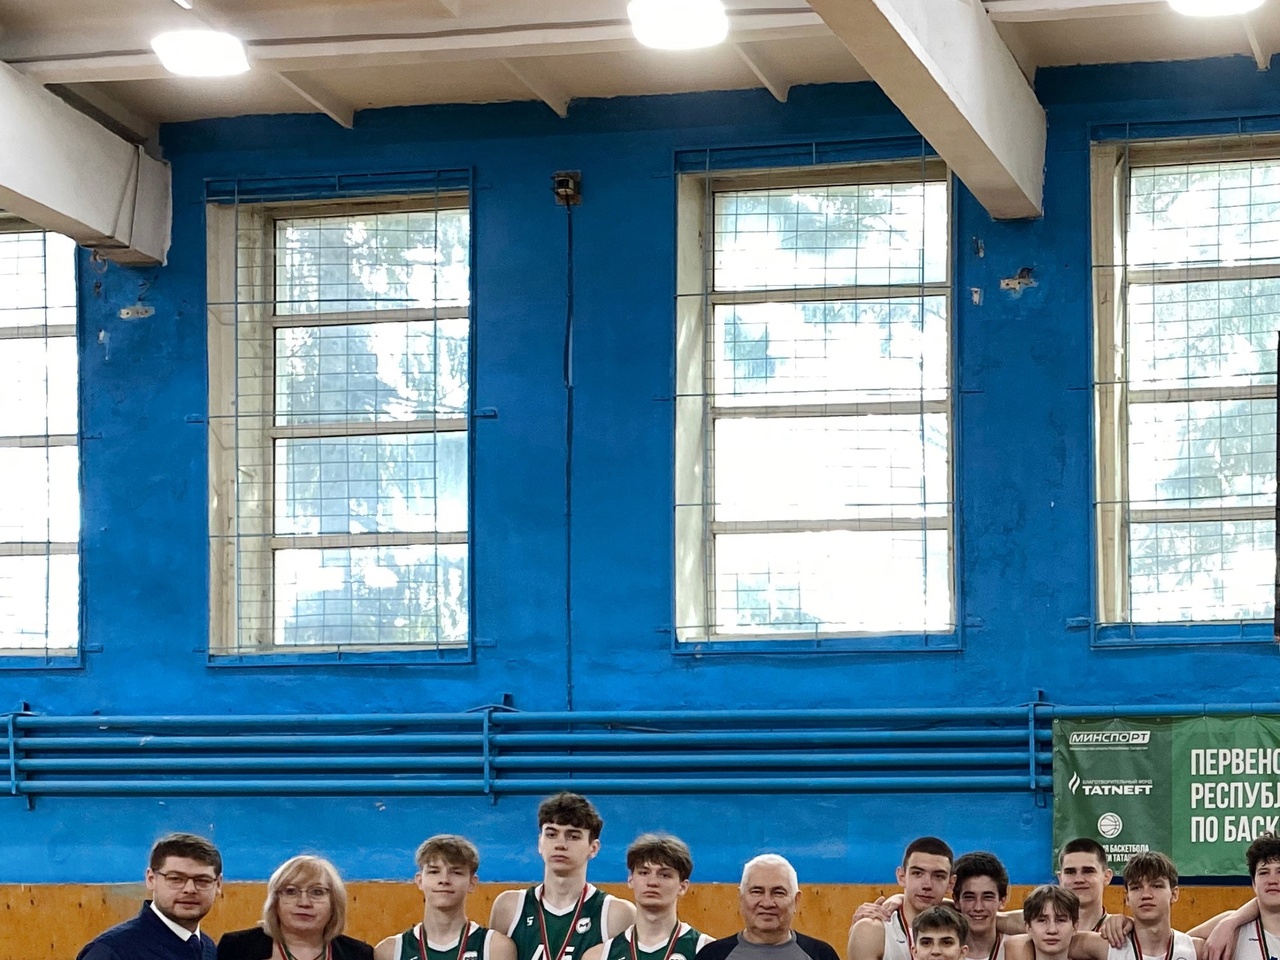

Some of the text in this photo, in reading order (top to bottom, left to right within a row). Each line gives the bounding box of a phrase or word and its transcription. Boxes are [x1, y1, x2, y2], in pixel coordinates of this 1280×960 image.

[1072, 733, 1148, 743] МИНСПОРТ
[1082, 785, 1153, 795] TATNEFT
[1191, 816, 1218, 842] ПО
